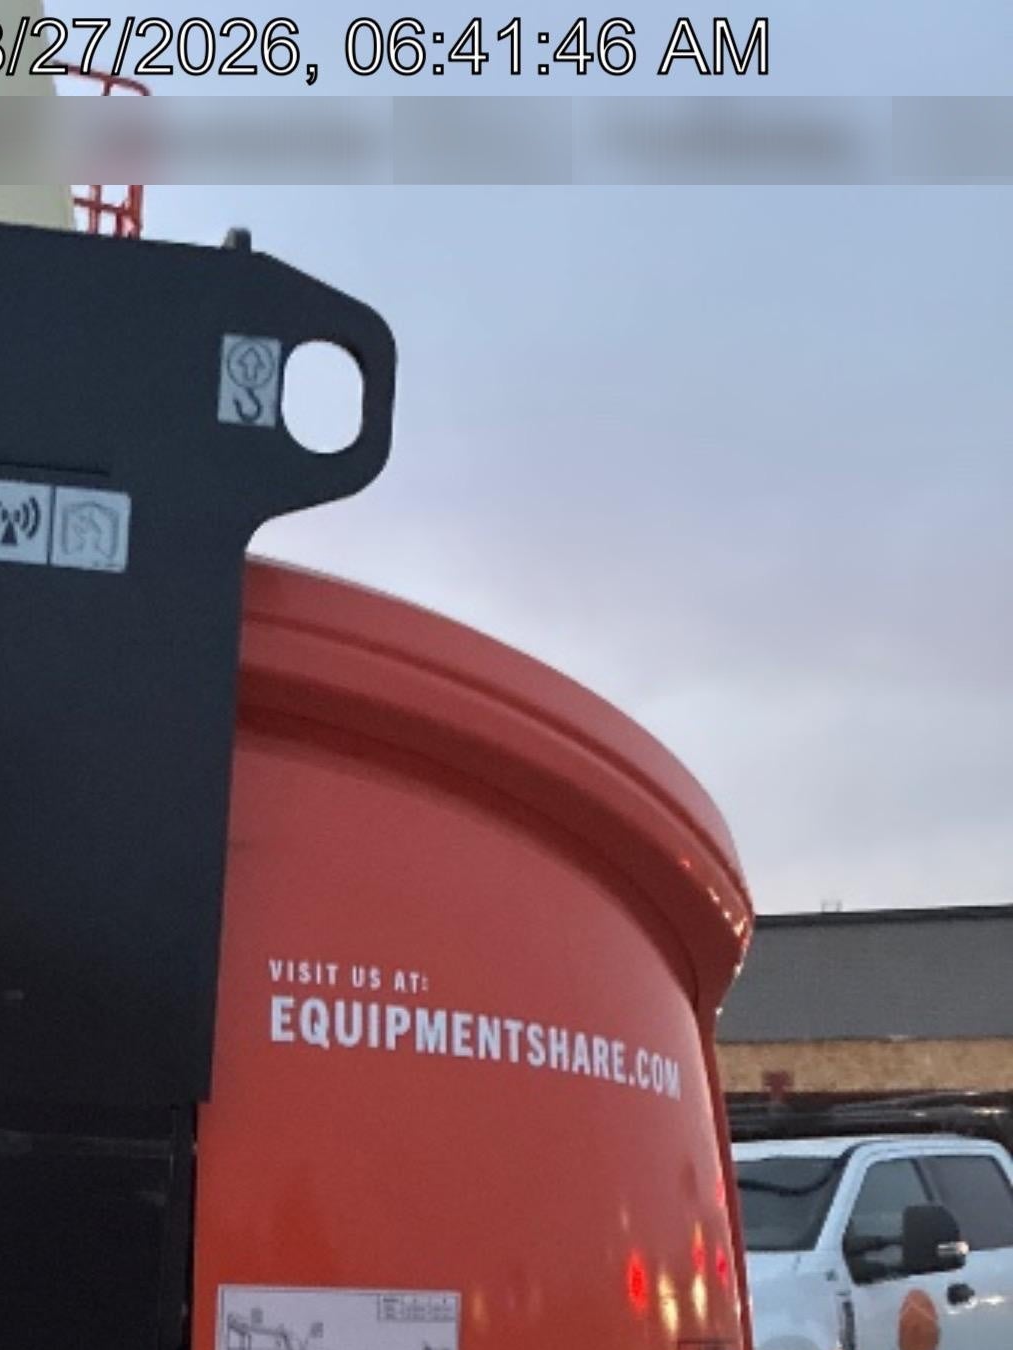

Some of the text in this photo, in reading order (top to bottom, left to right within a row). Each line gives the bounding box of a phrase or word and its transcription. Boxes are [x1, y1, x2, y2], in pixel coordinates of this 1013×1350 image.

[269, 959, 429, 992] VISIT US AT:
[270, 996, 681, 1100] EQUIPMENTSHARE.COM
